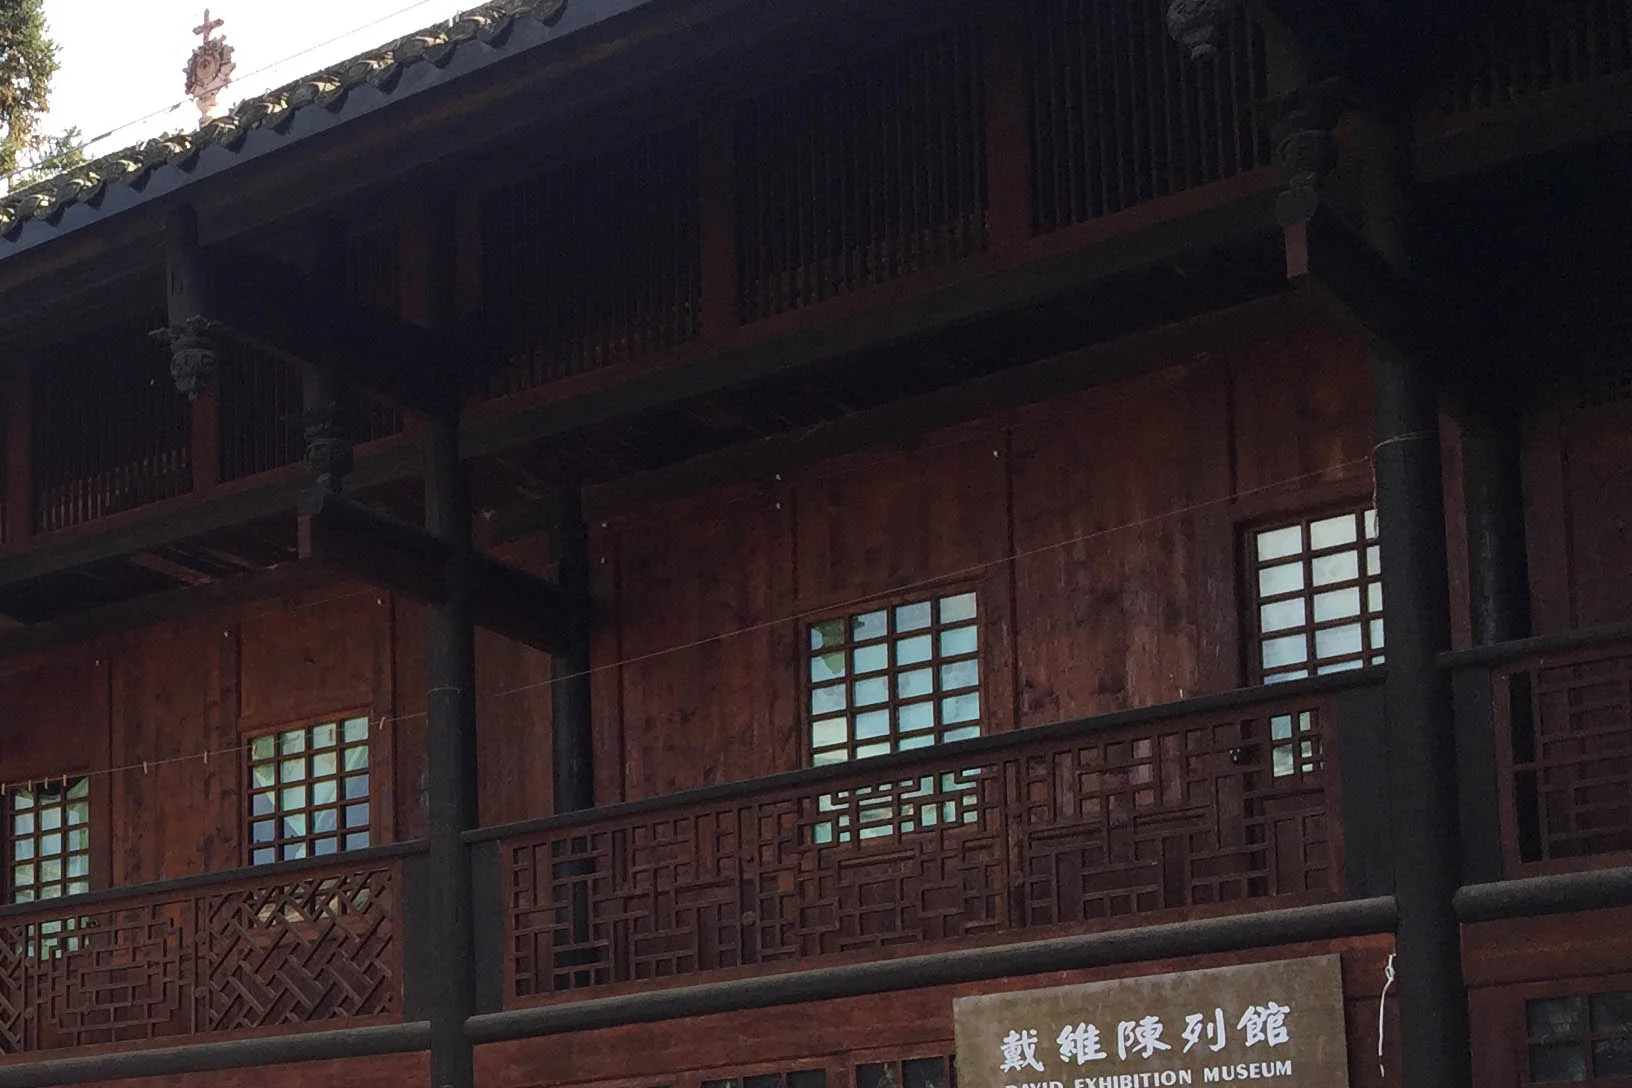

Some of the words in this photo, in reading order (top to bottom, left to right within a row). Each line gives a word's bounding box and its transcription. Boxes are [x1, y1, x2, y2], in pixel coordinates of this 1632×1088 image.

[999, 1001, 1291, 1073] 戴維陳列館
[1203, 1060, 1293, 1083] MUSEUM
